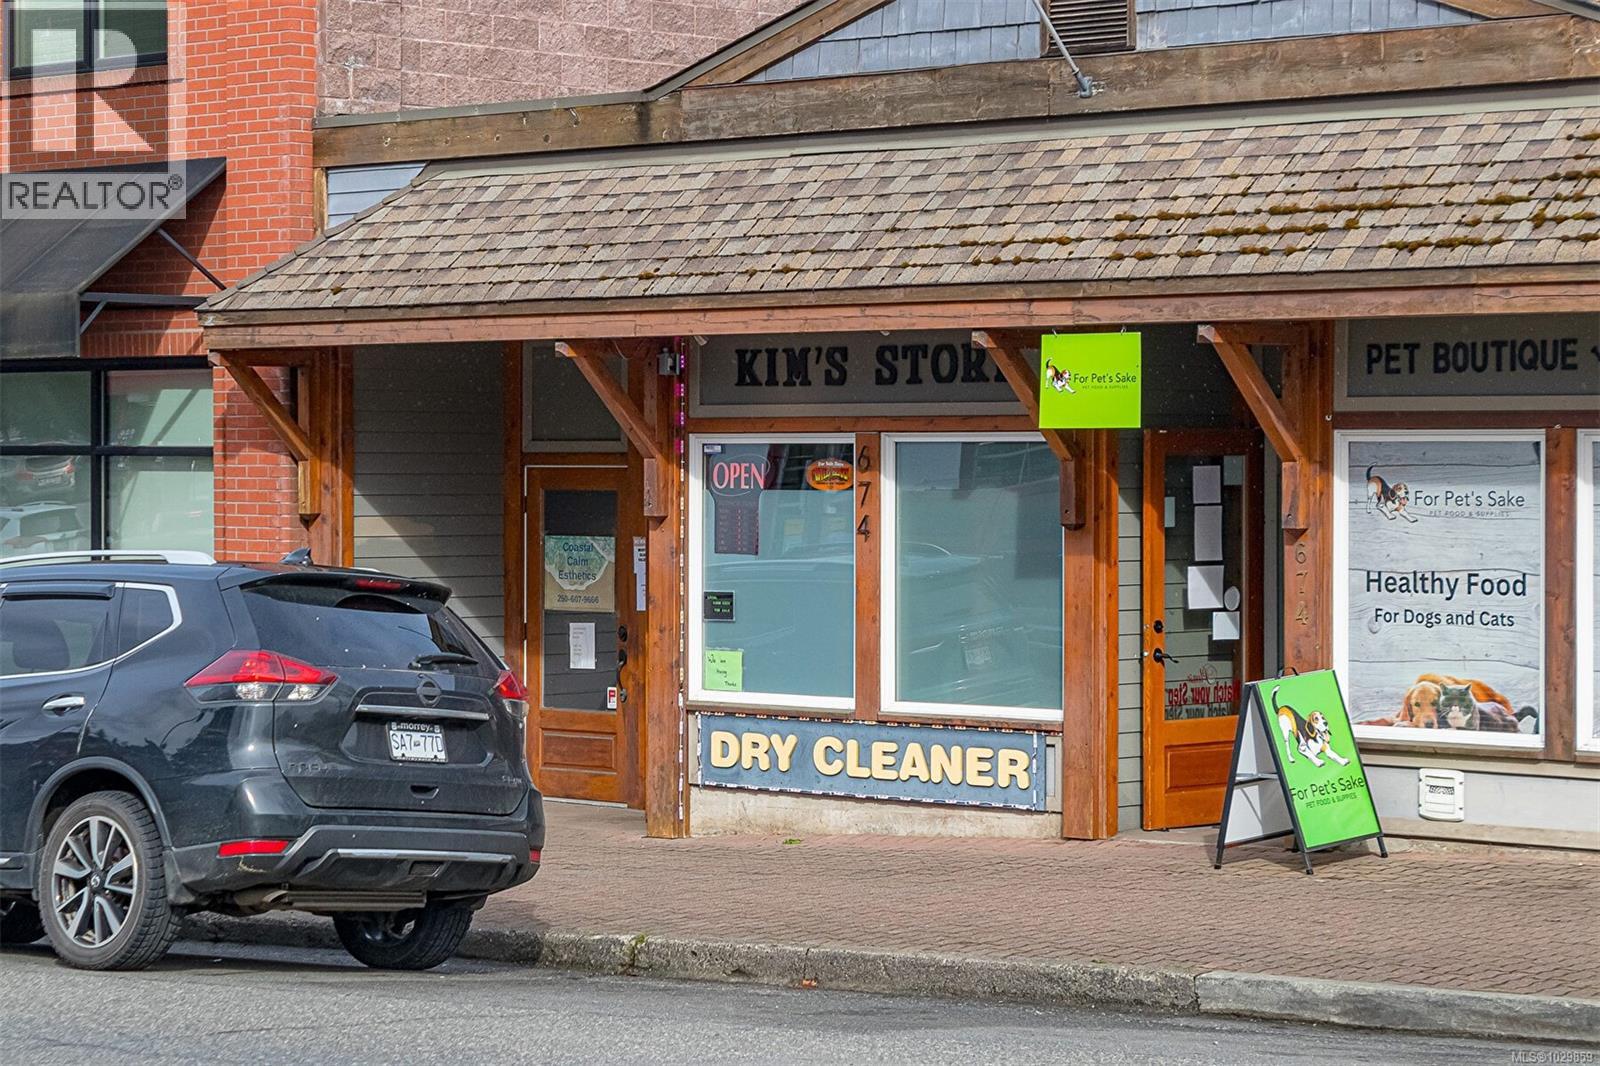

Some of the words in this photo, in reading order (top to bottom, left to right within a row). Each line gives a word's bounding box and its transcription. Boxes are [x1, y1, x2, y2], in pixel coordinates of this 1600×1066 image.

[1365, 342, 1422, 375] PET
[1432, 337, 1579, 374] BOUTIQUE
[734, 346, 849, 387] KIM'S
[1073, 373, 1089, 384] For
[1091, 372, 1114, 383] Pet's
[1115, 372, 1137, 383] Sake
[712, 461, 765, 490] OPEN
[1414, 490, 1440, 507] For
[1444, 490, 1483, 508] Pet's
[1487, 490, 1526, 508] Sake
[562, 542, 594, 552] Coastal
[566, 556, 589, 566] Calm
[558, 570, 597, 581] Esthetics
[1365, 570, 1459, 601] Healthy
[1466, 572, 1528, 597] Food
[1374, 608, 1399, 623] For
[1403, 608, 1442, 628] Dogs
[1445, 610, 1475, 626] and
[1479, 611, 1515, 627] Cats
[391, 732, 413, 751] SA7
[710, 730, 798, 772] DRY
[812, 735, 1030, 790] CLEANER
[1289, 786, 1309, 801] For
[1310, 780, 1338, 797] Pet's
[1338, 776, 1365, 792] Sake
